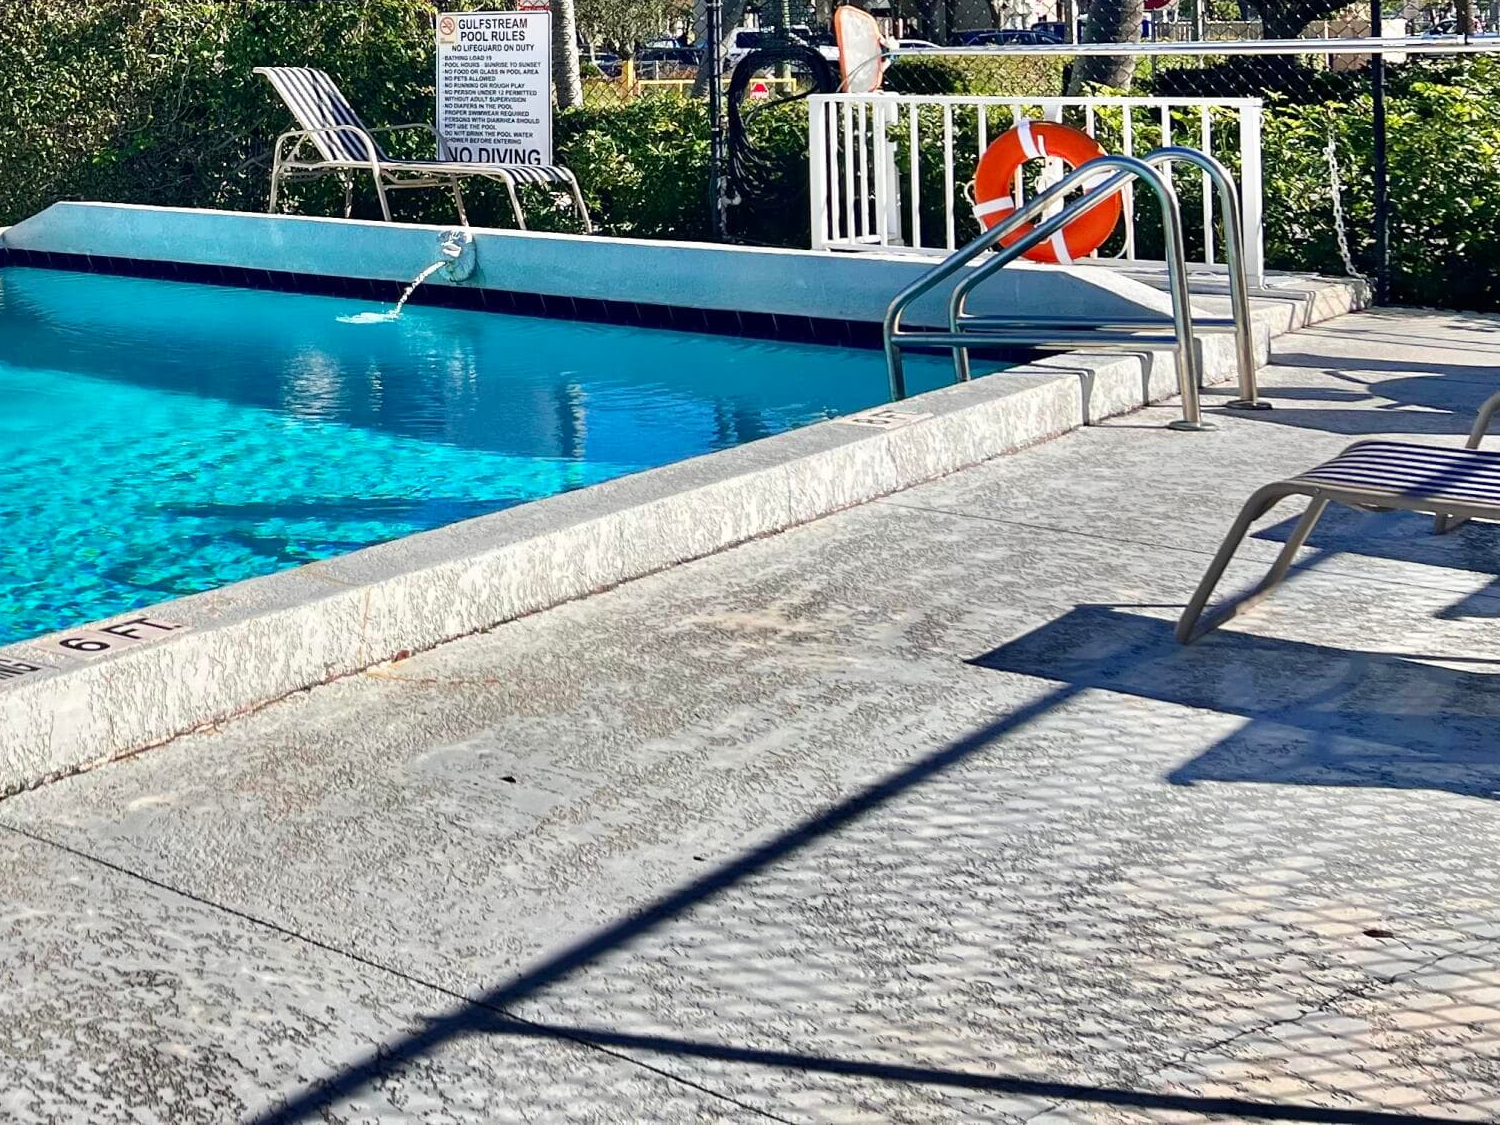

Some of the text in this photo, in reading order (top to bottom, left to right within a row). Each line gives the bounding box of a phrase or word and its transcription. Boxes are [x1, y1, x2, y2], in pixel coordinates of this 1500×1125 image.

[459, 18, 528, 30] GULFSTREAM
[460, 31, 489, 41] POOL
[491, 31, 525, 41] RULES
[451, 44, 535, 52] NO LIFEGUARD ON DUTY
[448, 146, 541, 165] NO DIVING
[59, 637, 110, 651] 6
